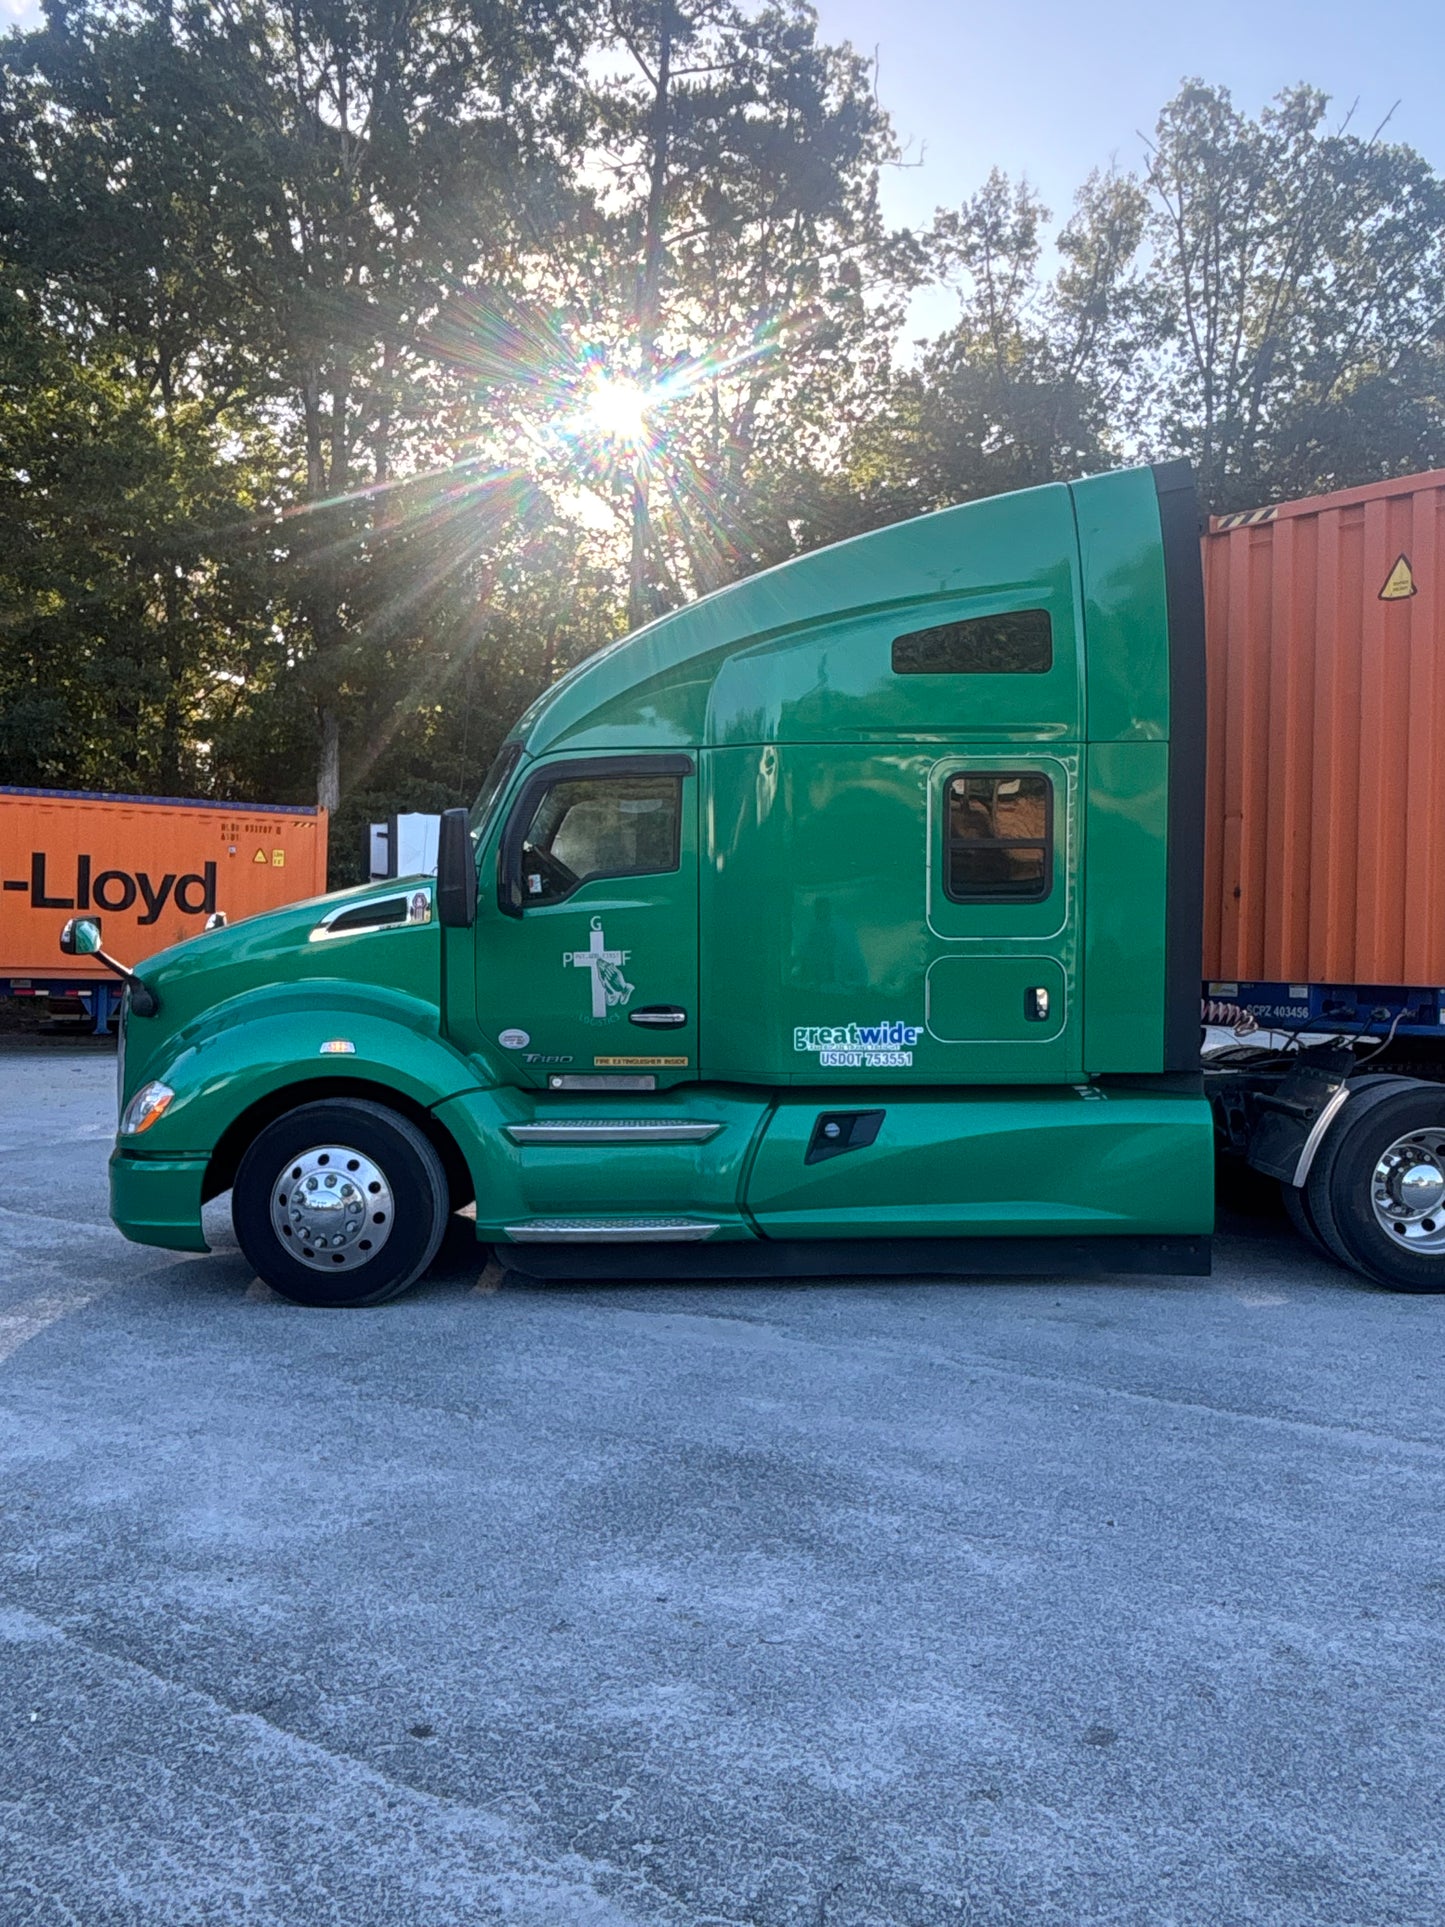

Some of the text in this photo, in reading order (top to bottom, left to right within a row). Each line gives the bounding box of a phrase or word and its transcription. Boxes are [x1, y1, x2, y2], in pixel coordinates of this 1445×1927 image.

[590, 916, 602, 931] G
[563, 952, 573, 968] P
[622, 950, 632, 966] F
[1246, 1004, 1309, 1018] SCPZ 403456
[821, 1052, 912, 1066] USDOT 753551
